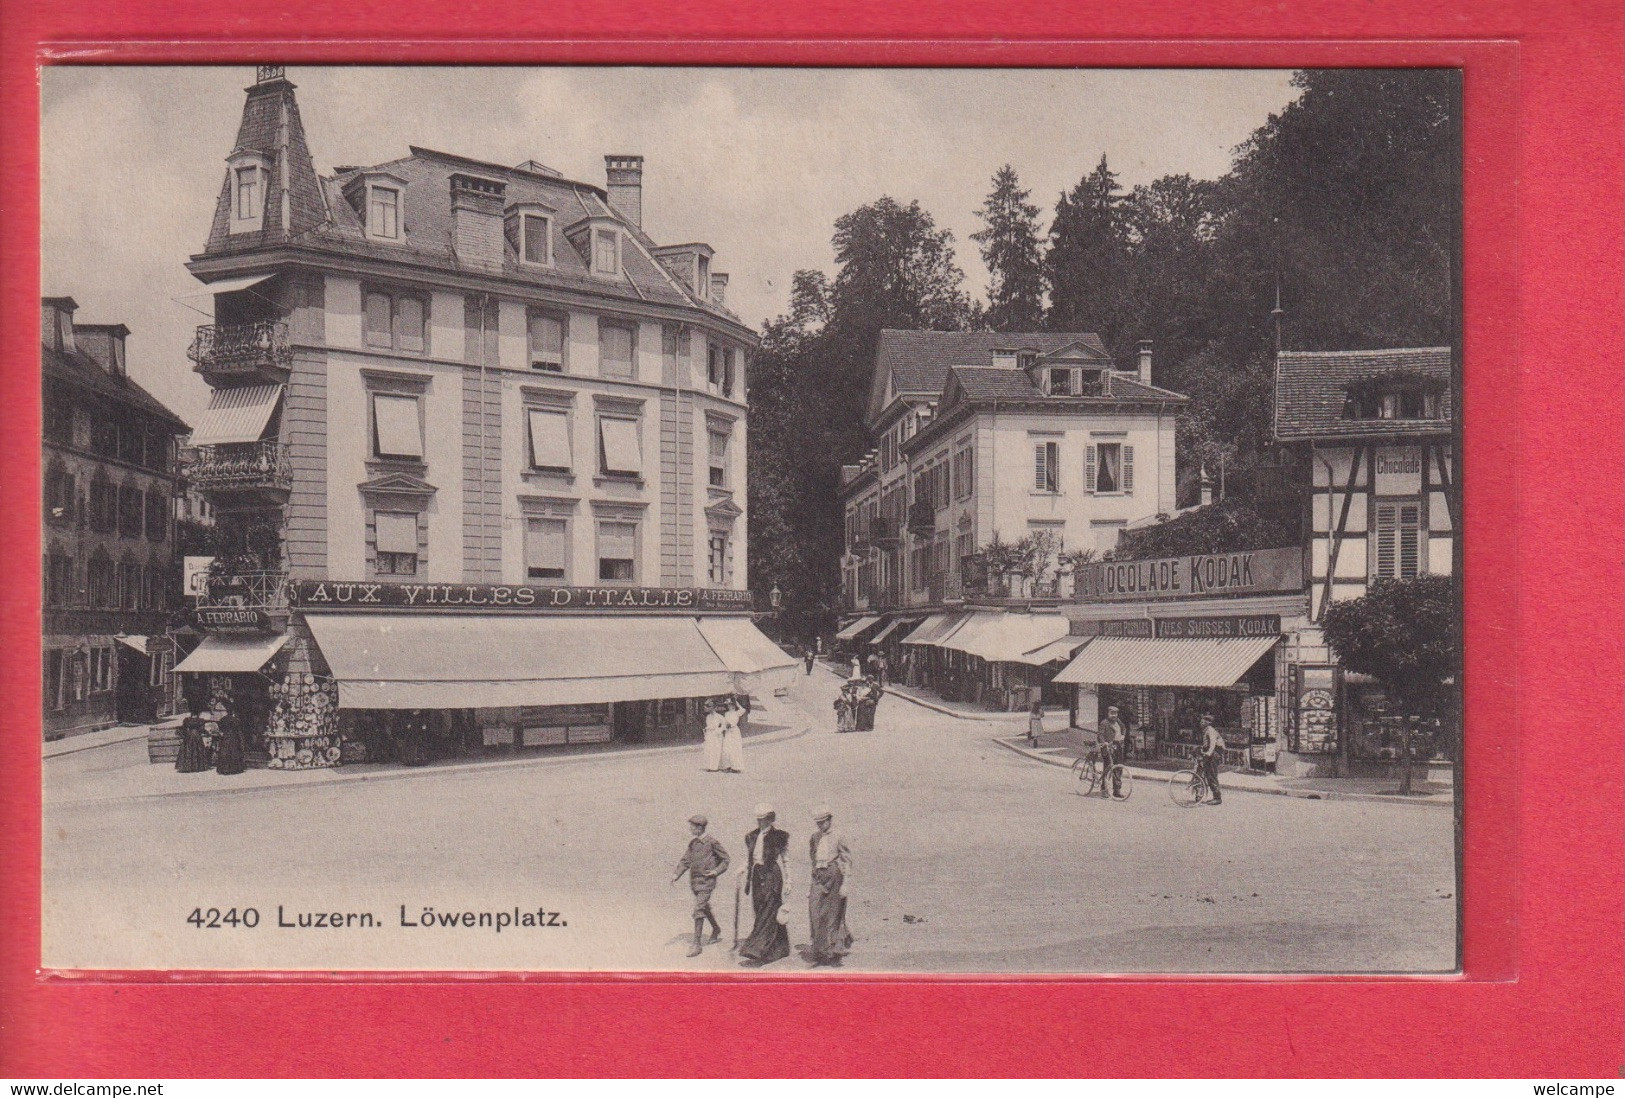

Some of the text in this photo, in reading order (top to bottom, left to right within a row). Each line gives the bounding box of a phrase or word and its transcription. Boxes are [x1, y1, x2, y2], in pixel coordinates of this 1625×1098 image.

[1376, 454, 1420, 474] Chocolade
[1188, 553, 1256, 595] KODAK
[307, 583, 694, 606] AUX VILLES D'ITALIE
[711, 590, 752, 601] FERRARIO
[206, 611, 258, 624] FERRARIO
